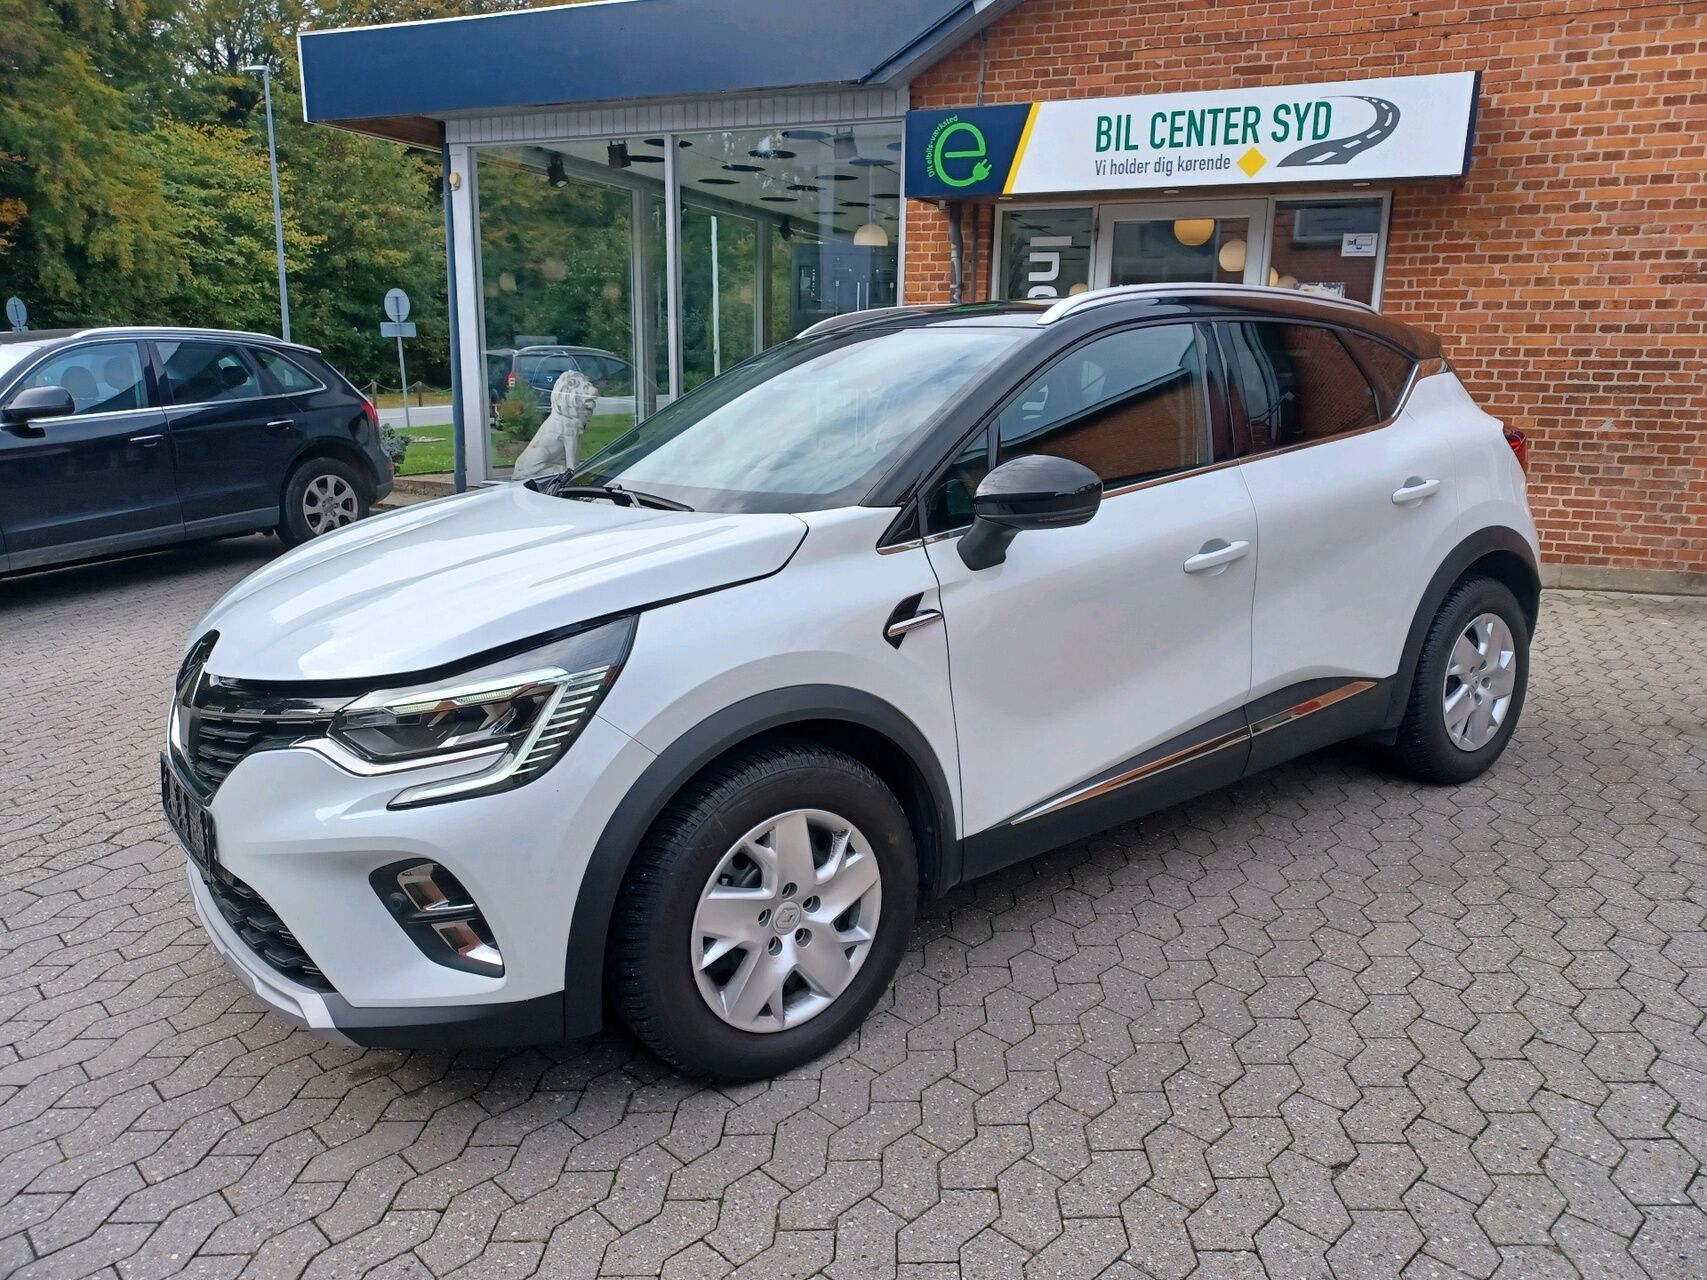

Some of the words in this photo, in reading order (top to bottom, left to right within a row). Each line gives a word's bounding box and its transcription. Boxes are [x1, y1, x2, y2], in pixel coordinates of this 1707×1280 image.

[1095, 114, 1139, 152] BIL
[1149, 106, 1261, 150] CENTER
[1271, 101, 1332, 143] SYD
[1095, 159, 1106, 176] Vi
[1110, 157, 1150, 175] holder
[1153, 156, 1173, 177] dig
[1177, 154, 1231, 172] kørende
